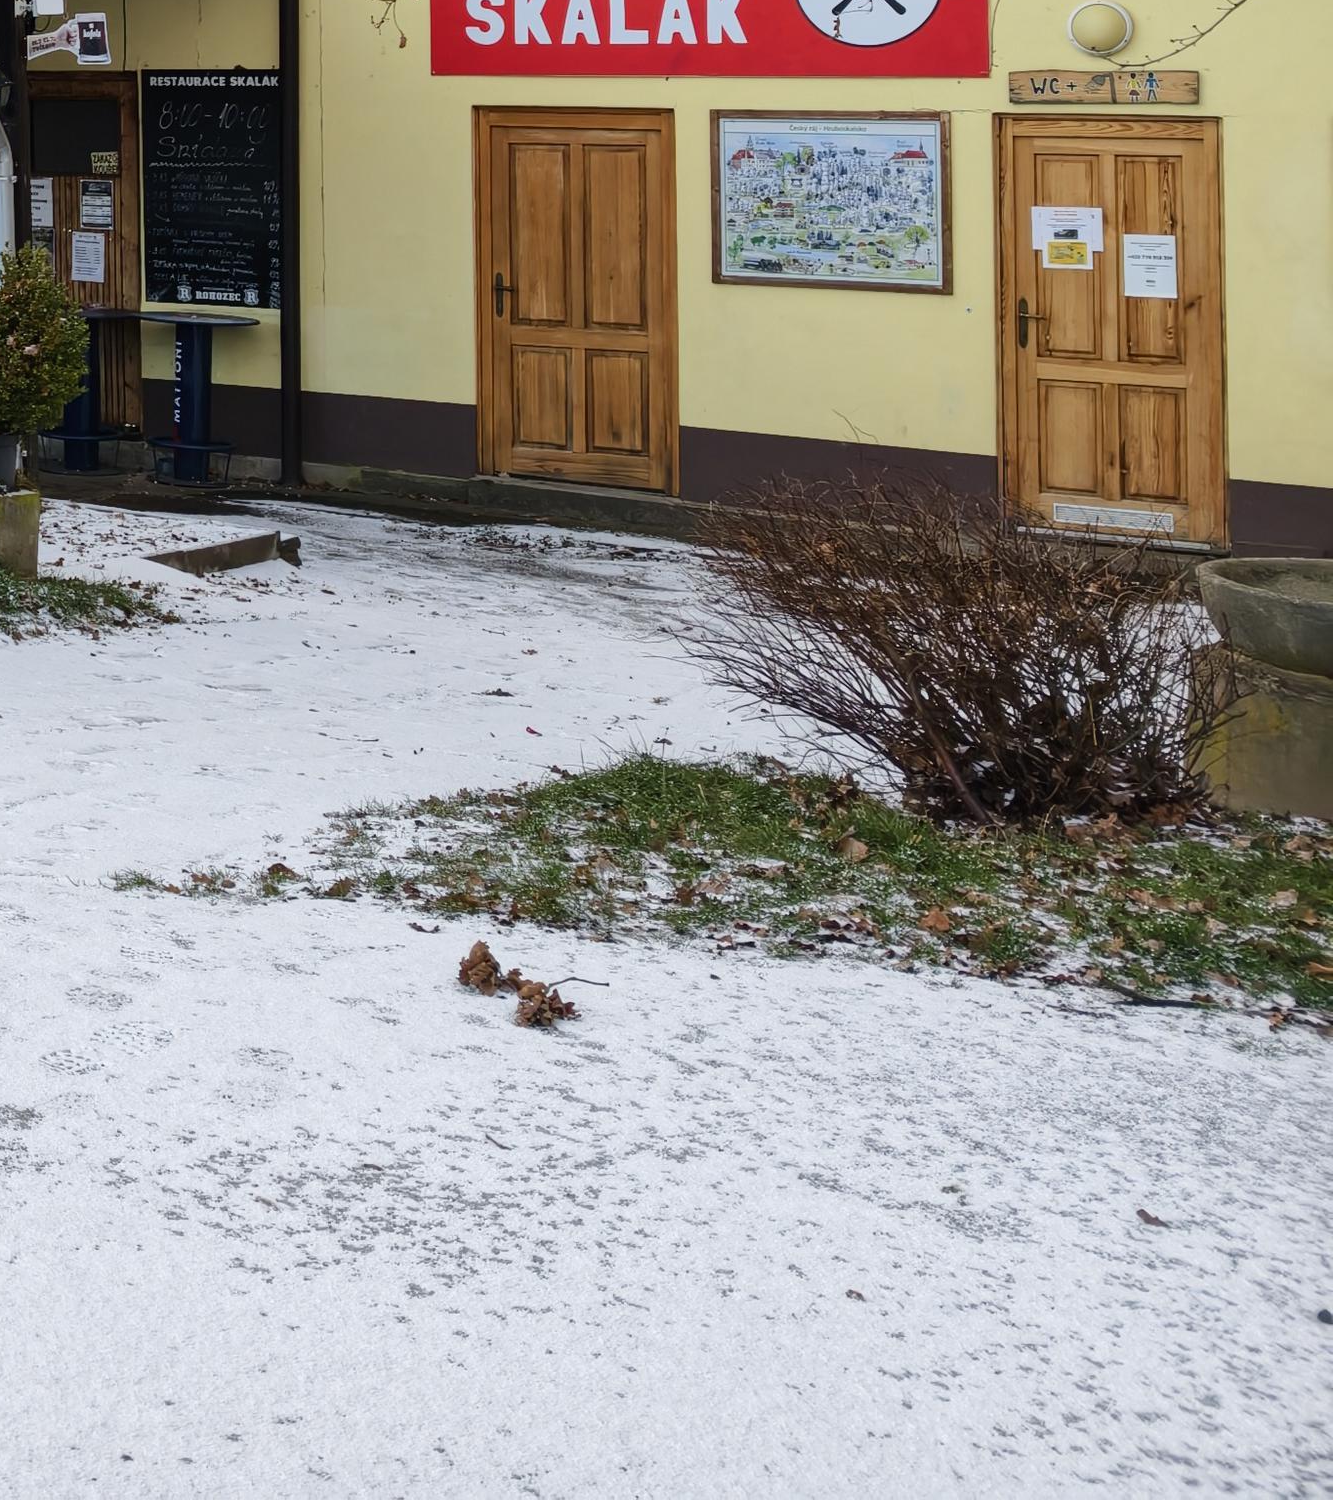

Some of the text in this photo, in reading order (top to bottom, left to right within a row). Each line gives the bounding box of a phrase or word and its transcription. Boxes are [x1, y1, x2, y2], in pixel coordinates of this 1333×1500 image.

[149, 76, 226, 87] RESTAURACE
[1030, 76, 1061, 95] WC
[195, 290, 241, 301] ROHOZEC
